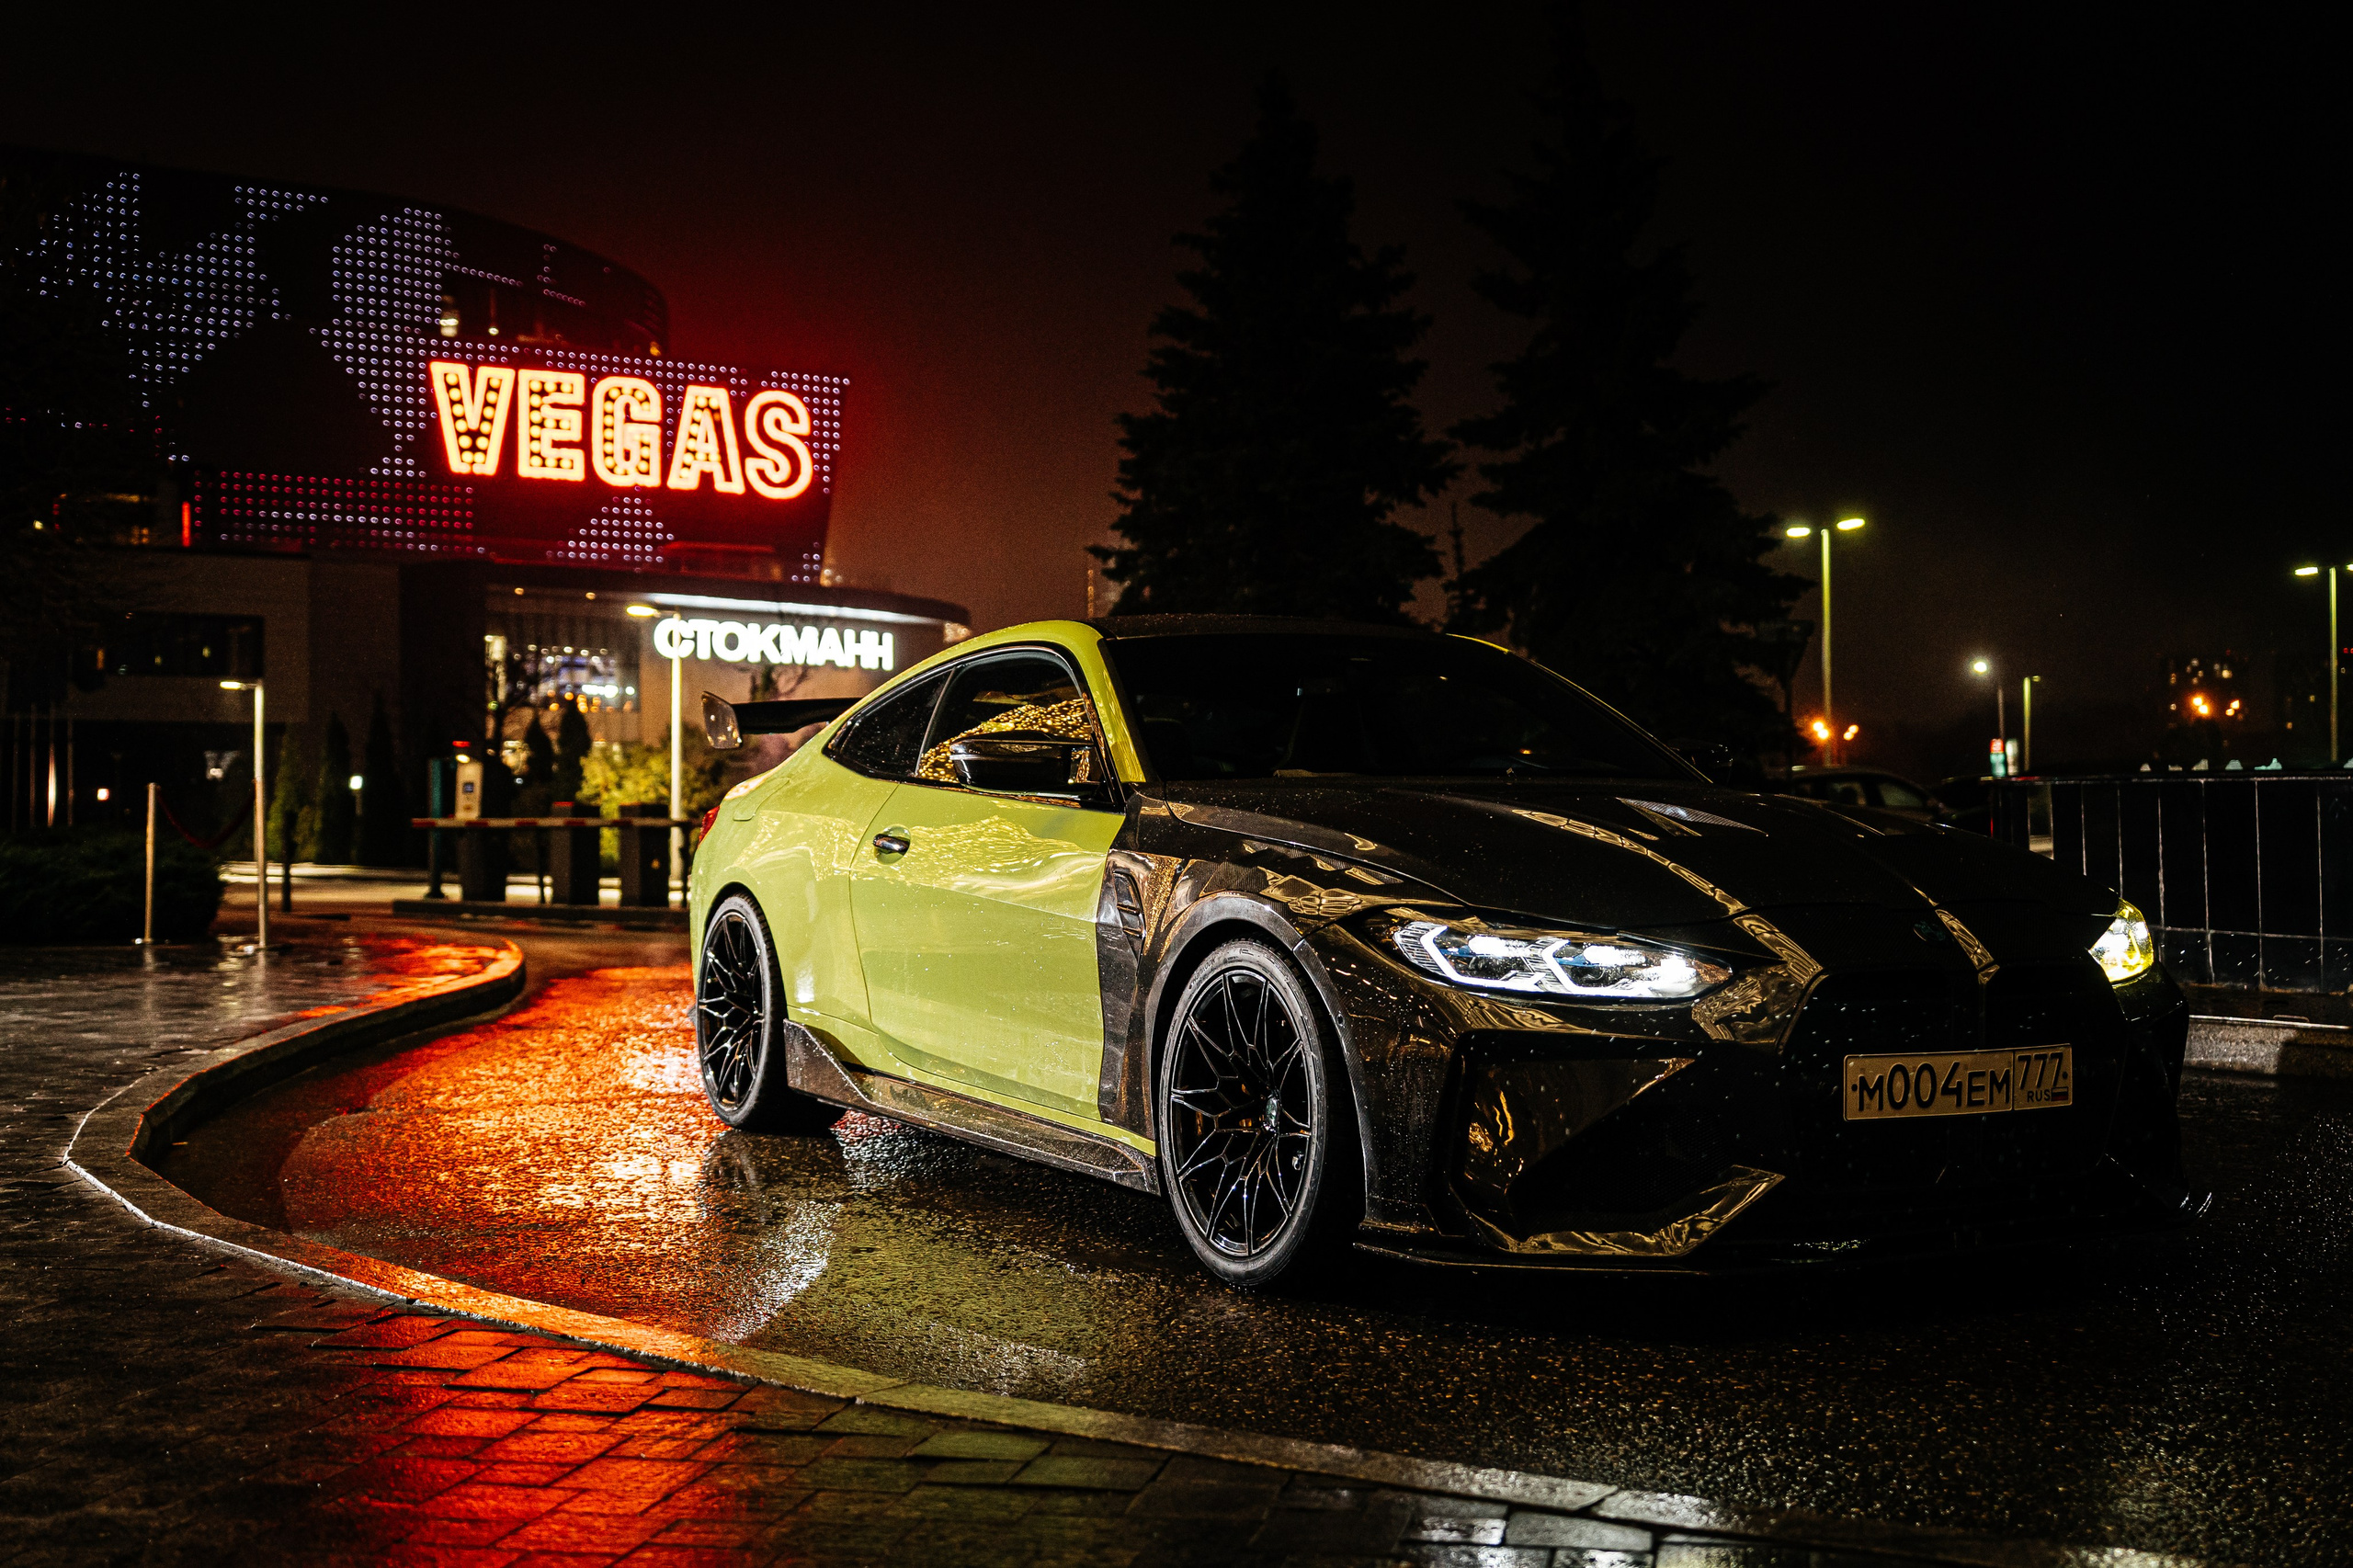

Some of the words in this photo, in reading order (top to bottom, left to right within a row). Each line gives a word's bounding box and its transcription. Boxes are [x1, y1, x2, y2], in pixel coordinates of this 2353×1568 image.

[429, 360, 814, 499] VEGAS
[654, 618, 894, 672] СТОКМАНН
[2017, 1051, 2063, 1090] 777
[2027, 1088, 2051, 1103] RUS
